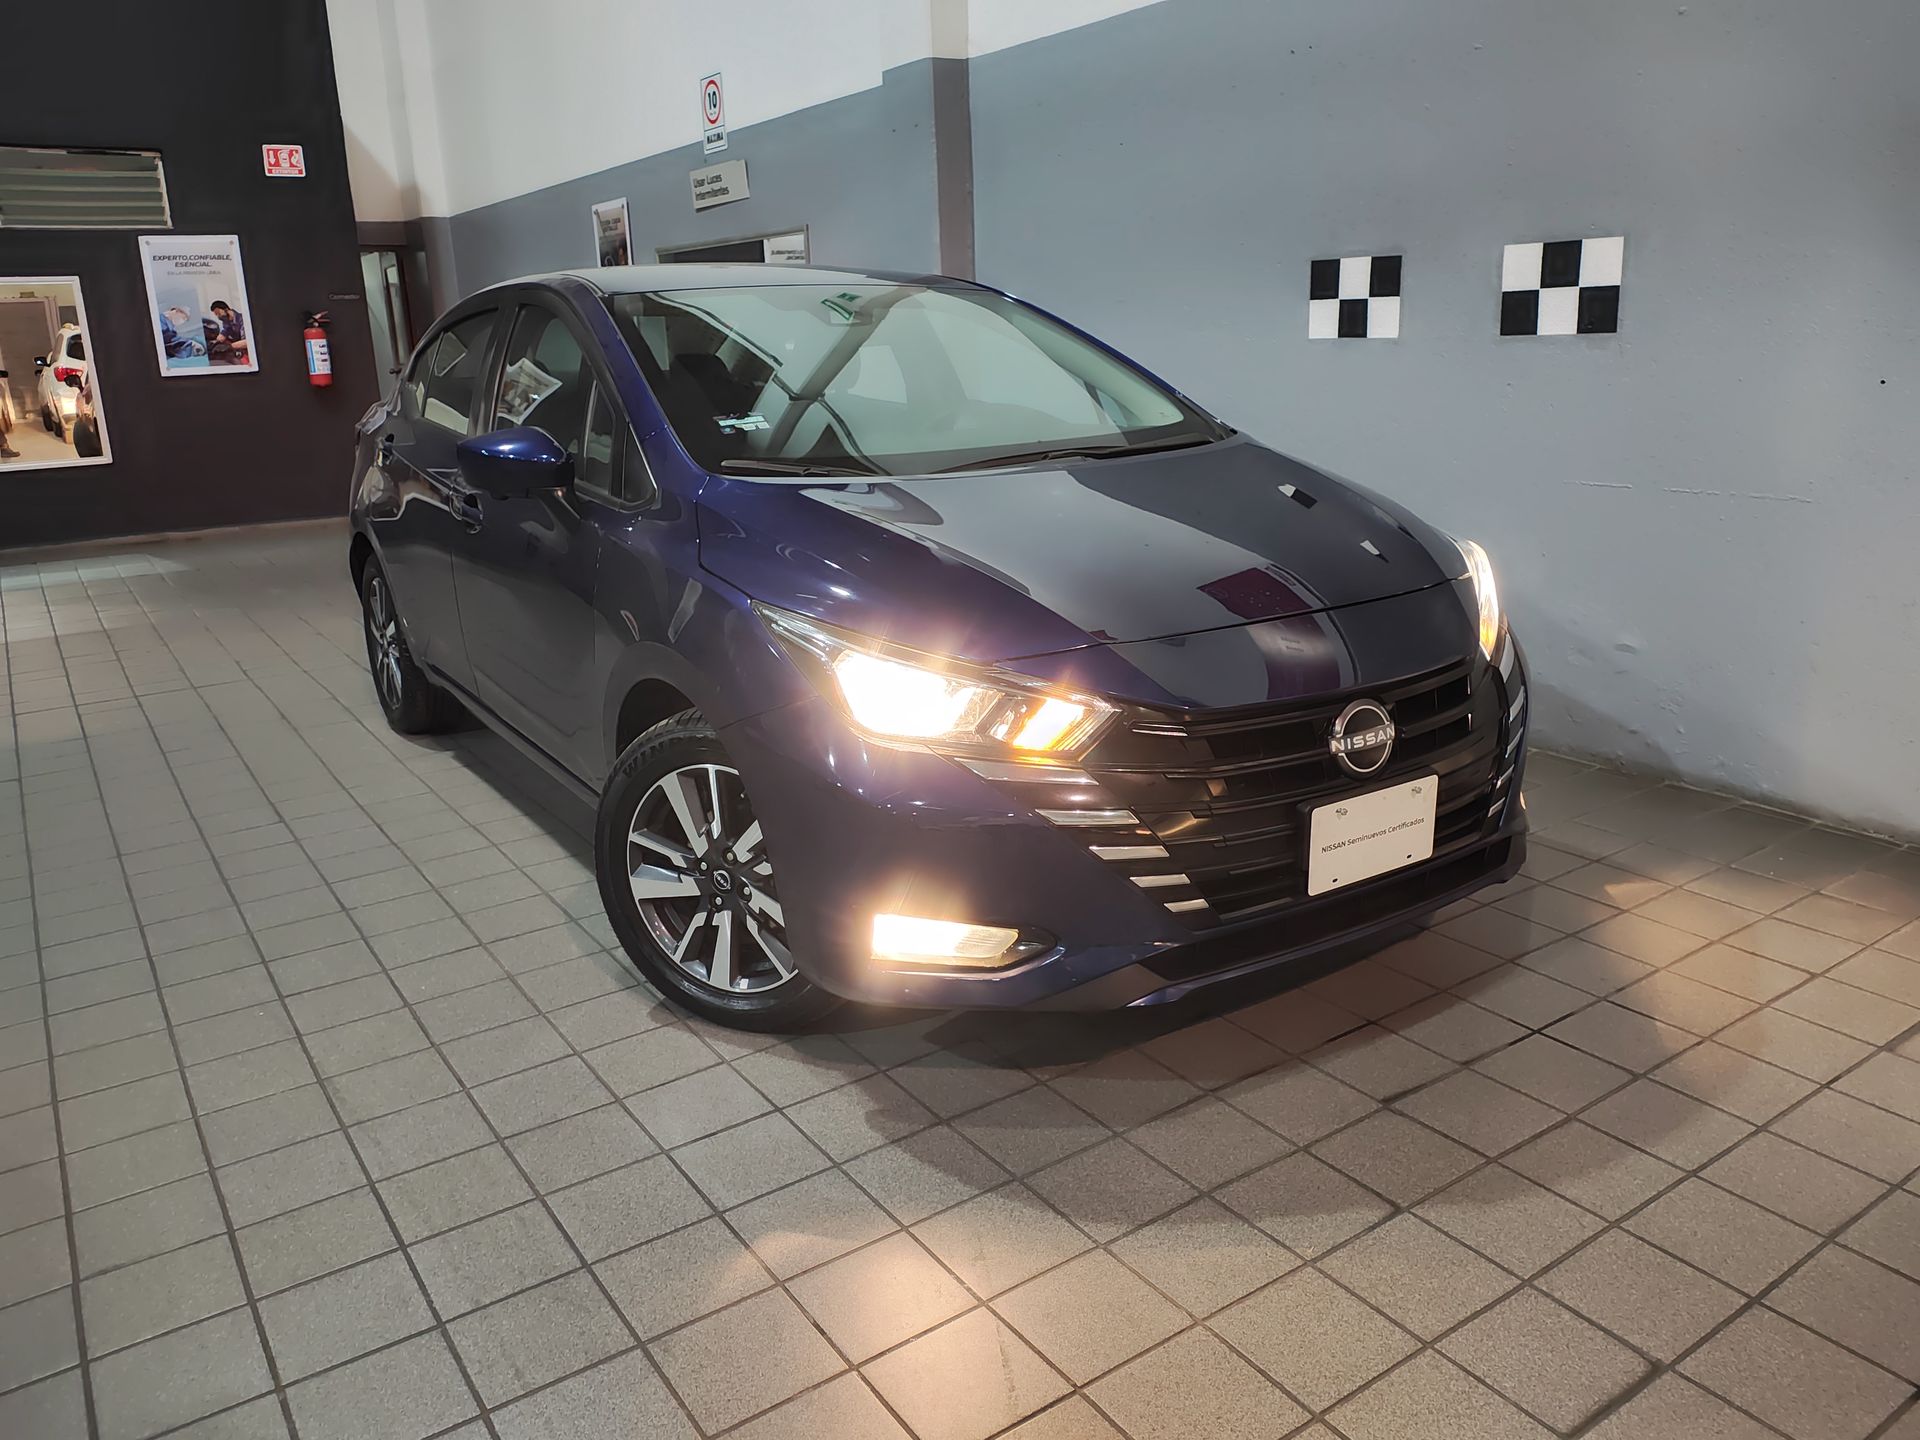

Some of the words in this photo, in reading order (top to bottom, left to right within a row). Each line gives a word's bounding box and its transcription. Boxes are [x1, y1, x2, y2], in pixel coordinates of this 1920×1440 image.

[708, 91, 717, 110] 10
[706, 174, 722, 185] Luces
[1331, 727, 1395, 752] NISSAN
[1321, 841, 1346, 853] NISSAN
[1347, 829, 1387, 846] Seminuevos
[1388, 817, 1425, 833] Certificados
